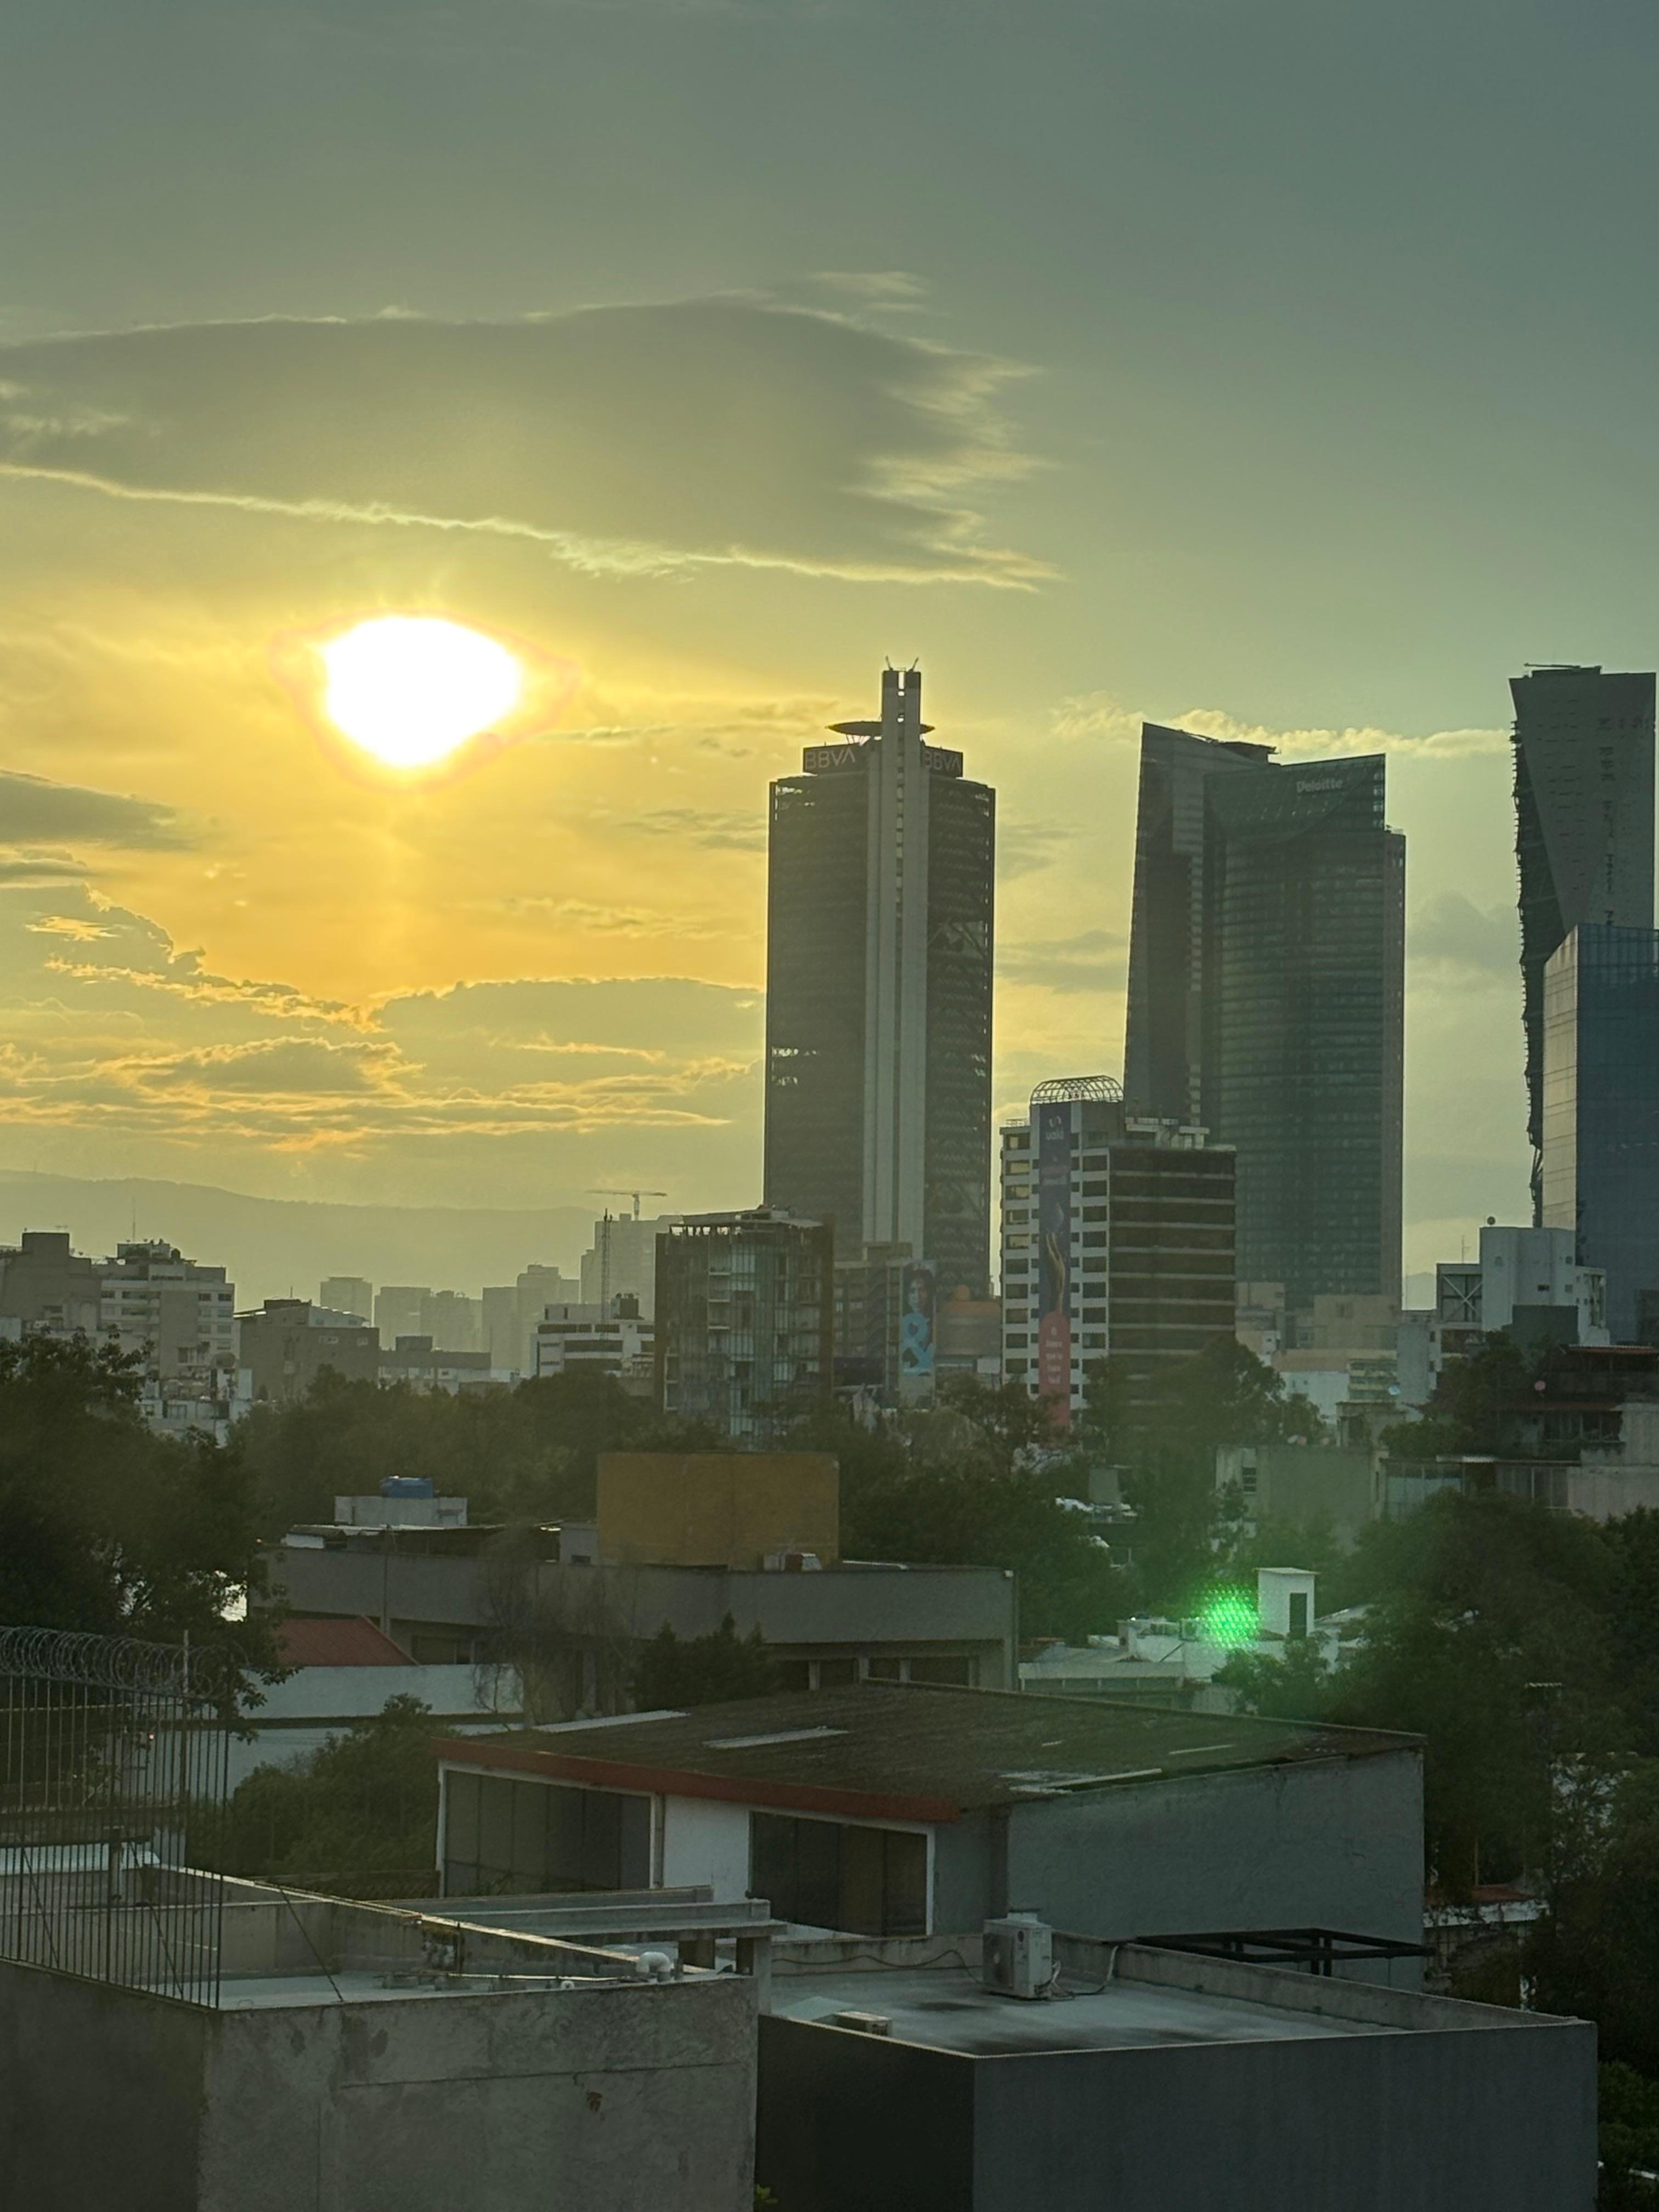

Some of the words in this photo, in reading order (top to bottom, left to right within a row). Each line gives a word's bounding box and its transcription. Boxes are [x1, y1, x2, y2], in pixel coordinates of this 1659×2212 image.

[805, 747, 856, 770] BBVA
[923, 752, 961, 771] BBVA
[1297, 778, 1342, 792] Deloitte
